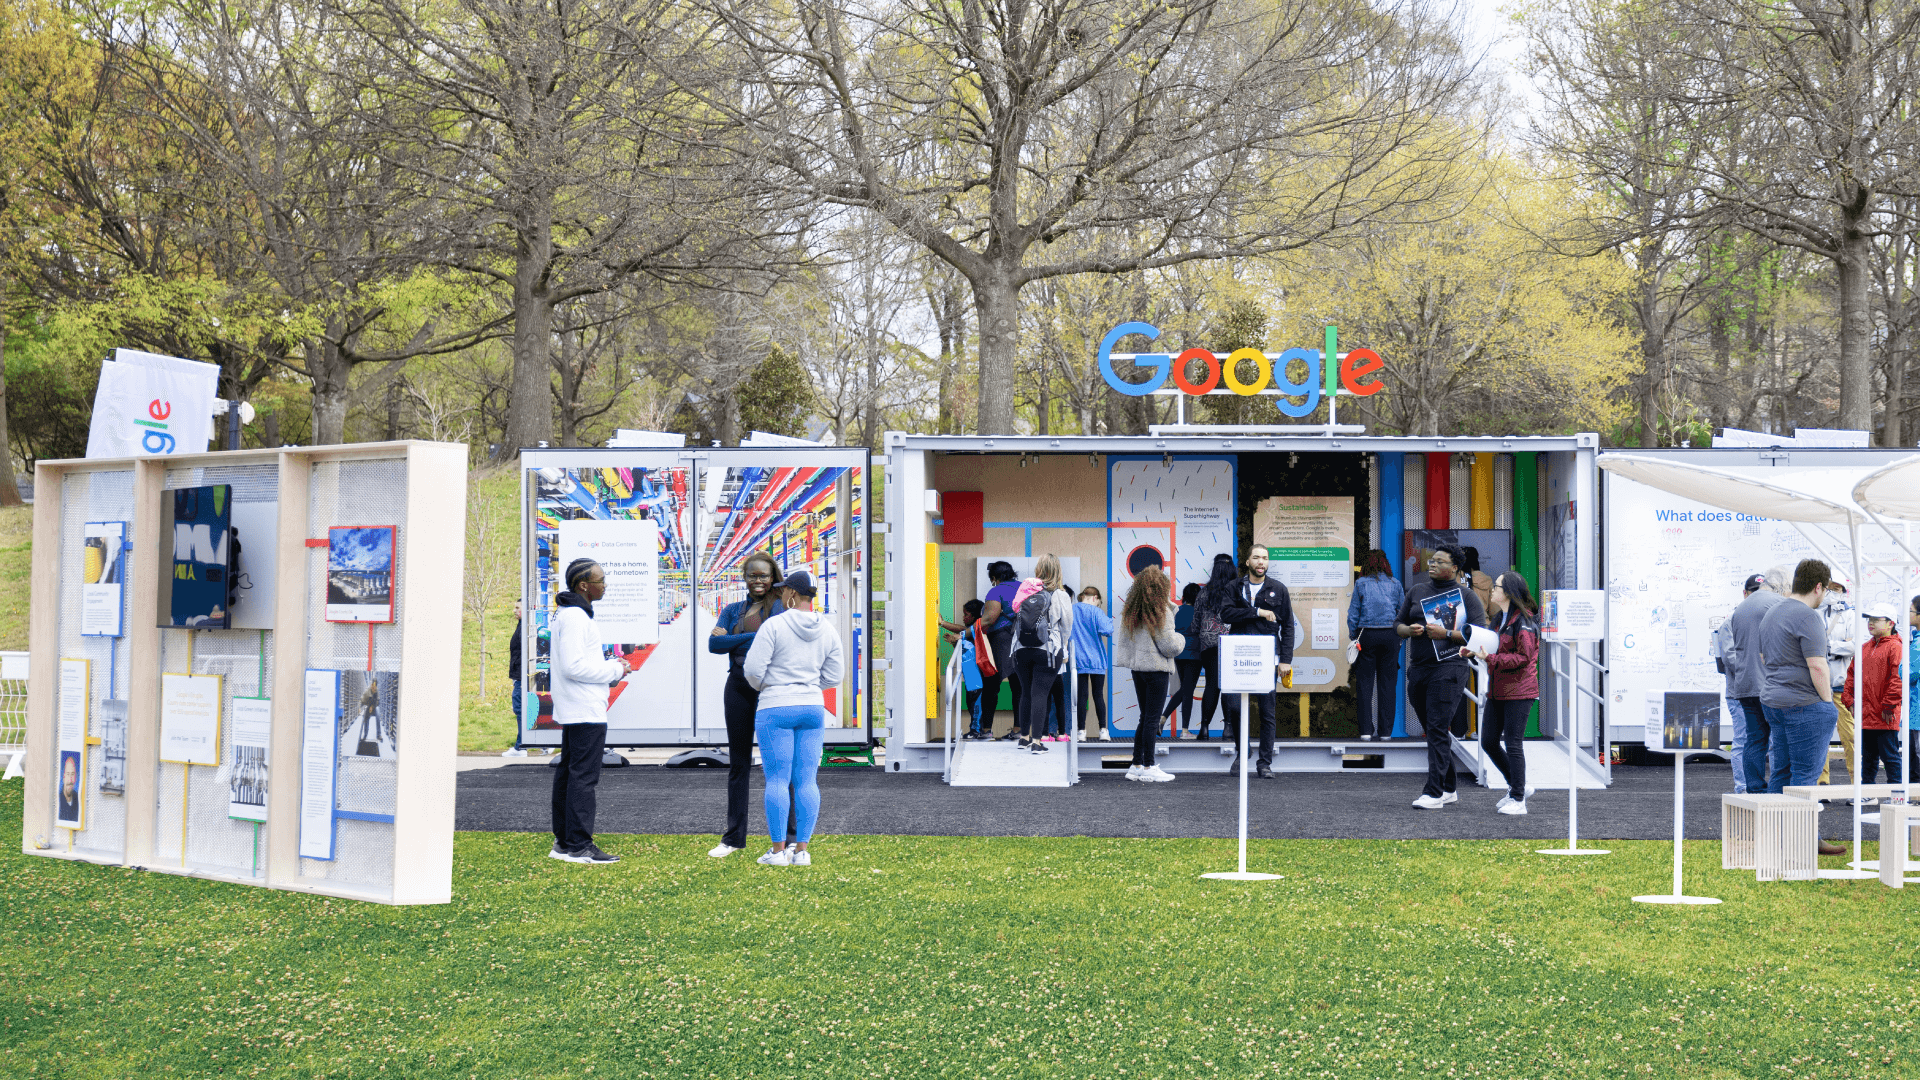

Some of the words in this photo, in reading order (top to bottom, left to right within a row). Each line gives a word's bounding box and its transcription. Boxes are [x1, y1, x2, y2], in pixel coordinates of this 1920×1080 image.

[1098, 321, 1384, 418] Google
[134, 398, 176, 454] gle
[1656, 510, 1693, 521] What
[1697, 510, 1732, 521] does
